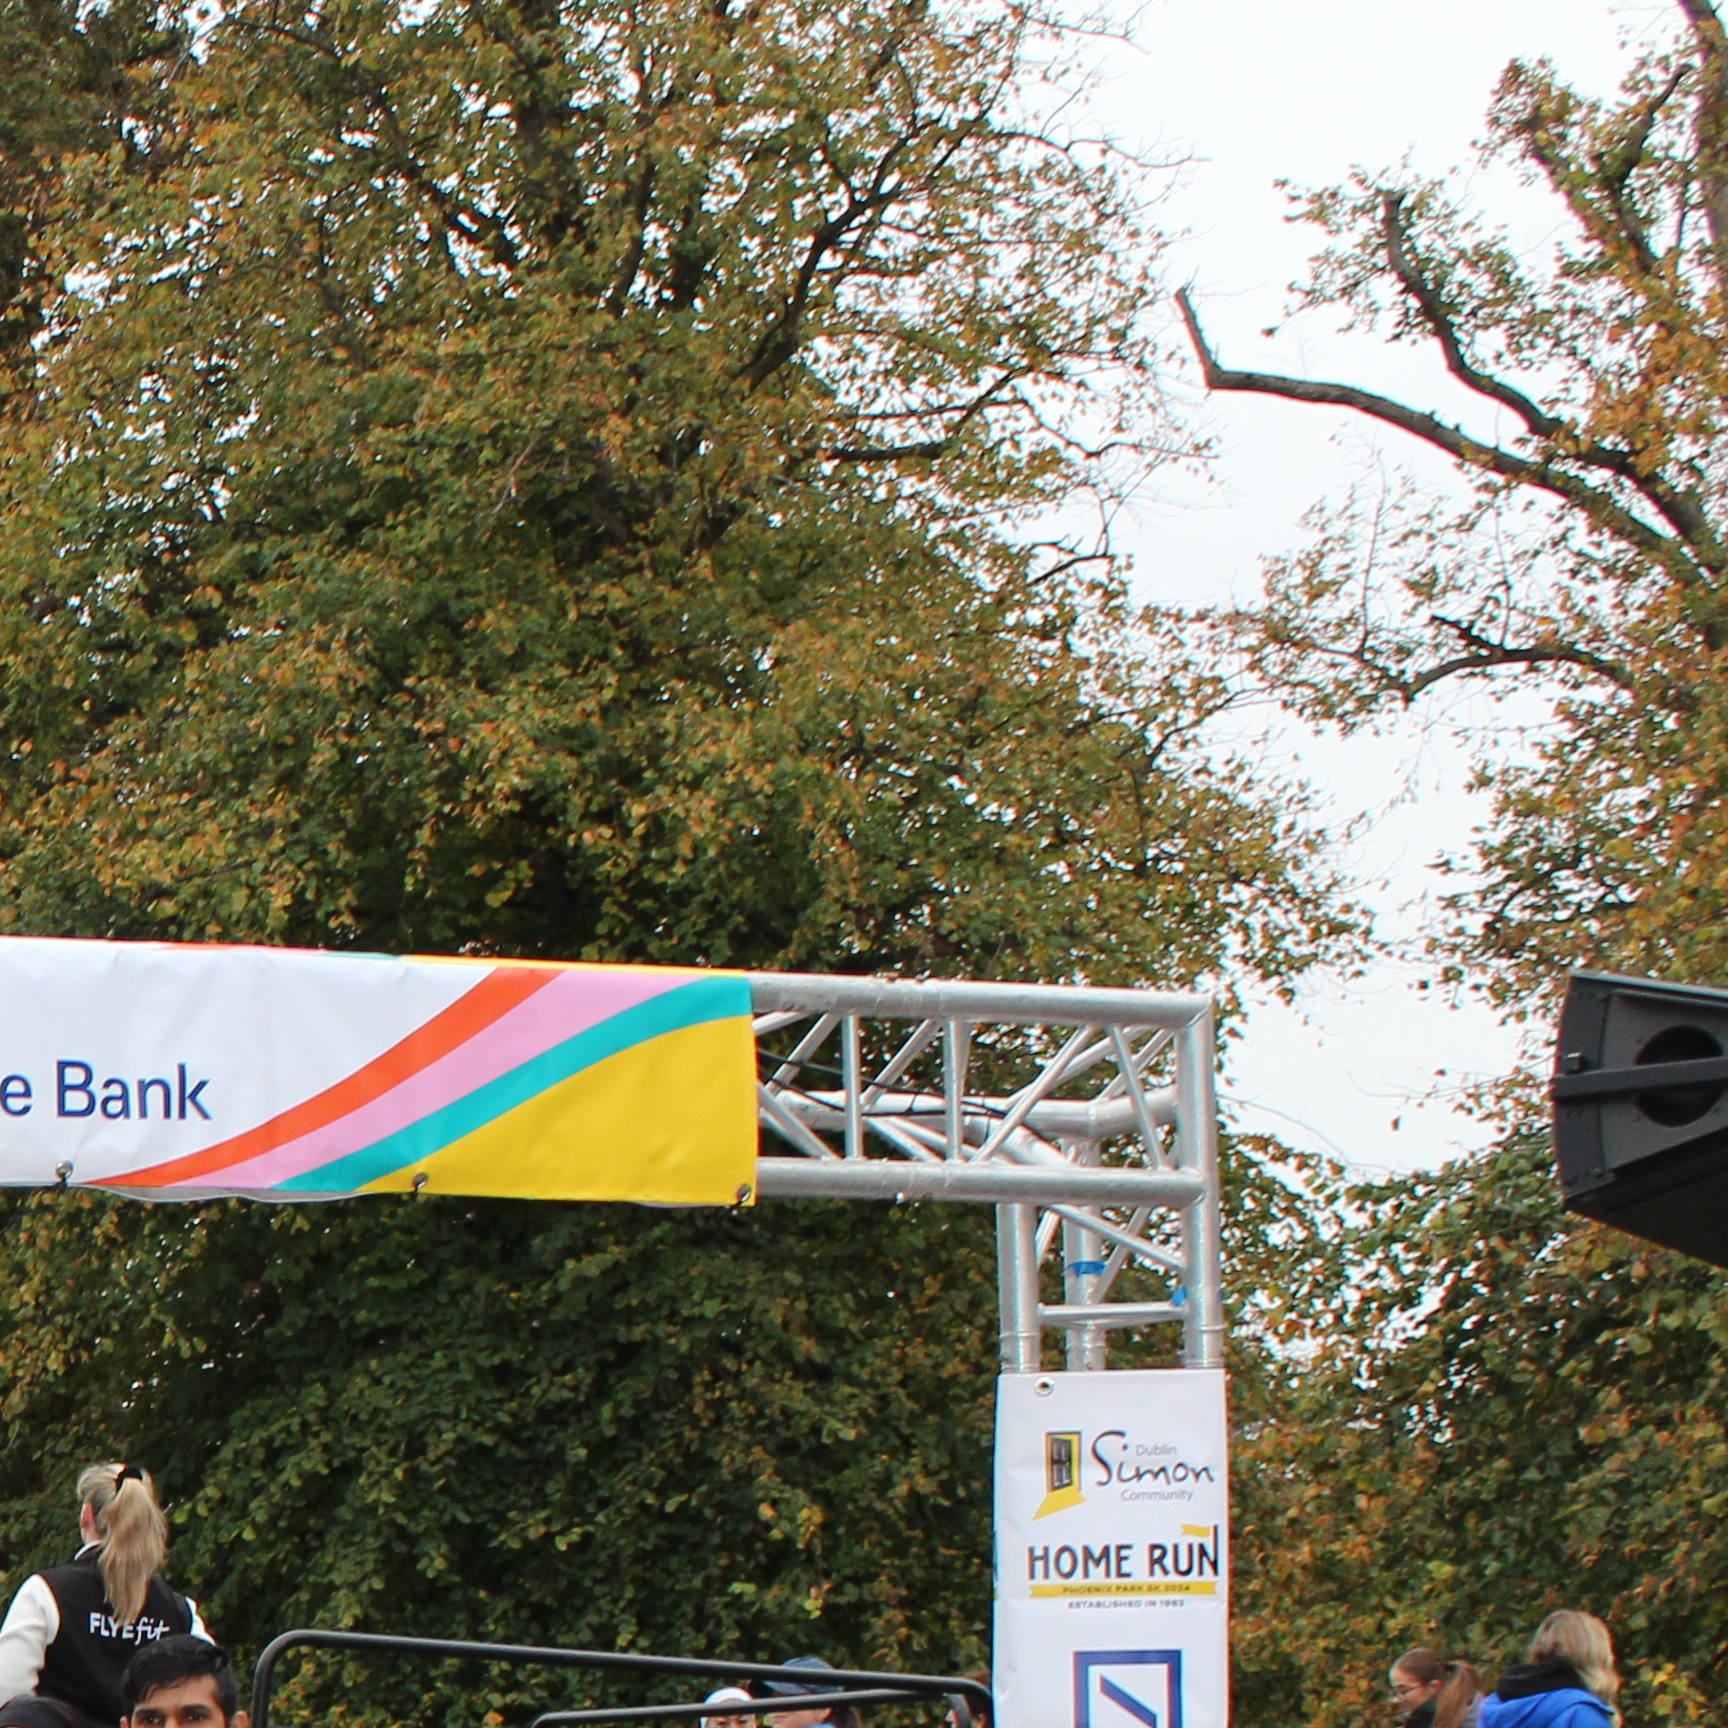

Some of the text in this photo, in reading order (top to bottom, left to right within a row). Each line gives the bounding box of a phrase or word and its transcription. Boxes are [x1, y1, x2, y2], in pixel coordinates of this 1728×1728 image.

[55, 1059, 214, 1121] Bank
[1135, 1444, 1177, 1457] Dublin
[1090, 1430, 1215, 1486] Simon
[1120, 1489, 1194, 1502] Community
[1027, 1524, 1220, 1581] HOME RUN
[1062, 1586, 1114, 1594] PHOENIX
[1115, 1585, 1144, 1593] PARK
[1164, 1584, 1190, 1593] 2024
[1067, 1600, 1142, 1610] ESTABLISHED
[1145, 1599, 1157, 1608] IN
